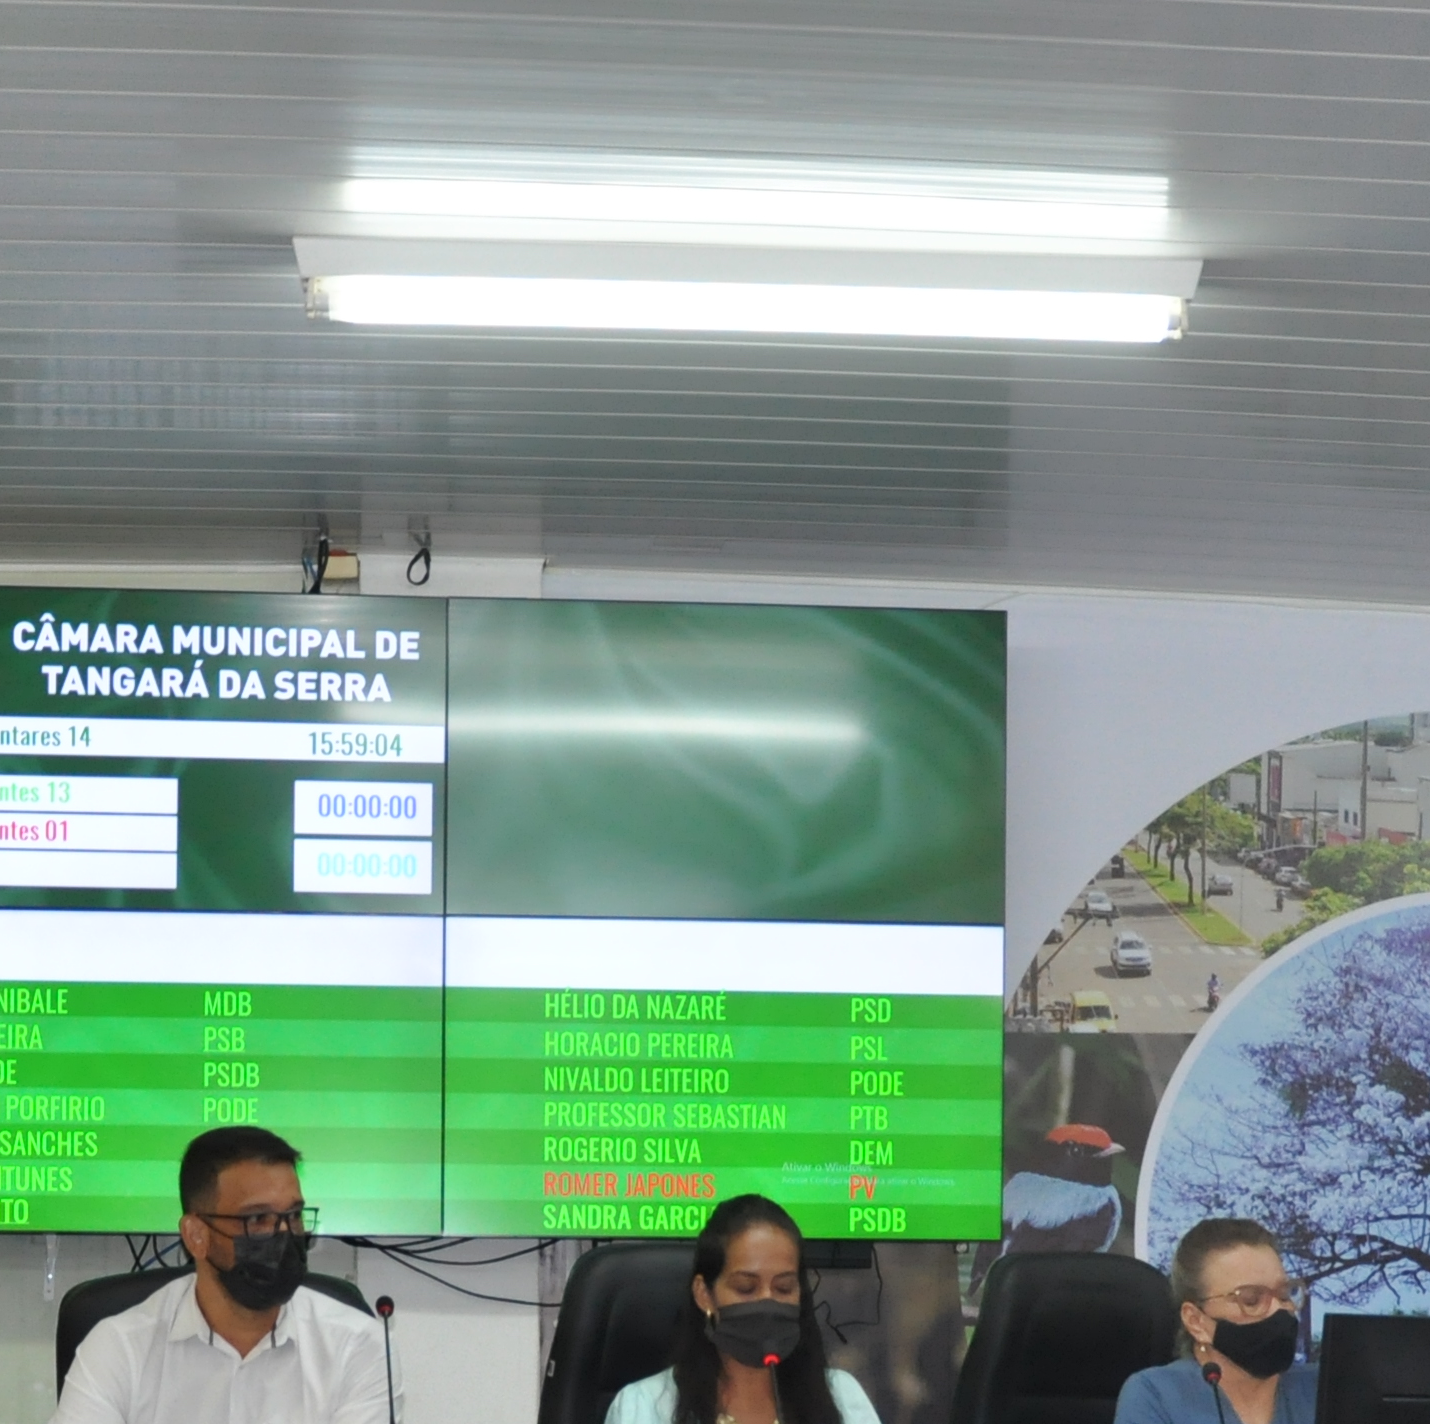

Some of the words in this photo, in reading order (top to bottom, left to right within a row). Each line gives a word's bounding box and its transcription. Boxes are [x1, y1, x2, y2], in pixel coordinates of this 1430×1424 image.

[12, 613, 164, 653] CÂMARA
[173, 623, 366, 660] MUNICIPAL
[376, 630, 420, 662] DE
[41, 658, 208, 699] TANGARÁ
[219, 668, 266, 700] DA
[272, 670, 392, 702] SERRA
[68, 724, 92, 748] 14
[308, 731, 403, 758] 15:59:04
[46, 781, 71, 804] 13
[317, 793, 417, 820] 00:00:00
[45, 818, 69, 842] 01
[316, 852, 417, 879] 00:00:00
[203, 991, 253, 1018] MDB
[544, 988, 605, 1019] HÉLIO
[612, 993, 639, 1020] DA
[647, 990, 727, 1021] NAZARÉ
[850, 997, 892, 1024] PSD
[203, 1026, 246, 1053] PSB
[544, 1031, 640, 1058] HORACIO
[647, 1032, 734, 1060] PEREIRA
[850, 1035, 888, 1062] PSL
[203, 1062, 260, 1089] PSDB
[544, 1067, 633, 1094] NIVALDO
[640, 1068, 730, 1095] LEITEIRO
[850, 1070, 905, 1097] PODE
[5, 1095, 105, 1122] PORFIRIO
[203, 1097, 259, 1124] PODE
[544, 1102, 666, 1129] PROFESSOR
[673, 1103, 787, 1130] SEBASTIAN
[850, 1105, 889, 1132] PTB
[543, 1136, 636, 1164] ROGERIO
[643, 1137, 702, 1165] SILVA
[849, 1140, 894, 1166] DEM
[782, 1162, 812, 1172] Ativar
[543, 1171, 617, 1199] ROMER
[624, 1172, 716, 1199] JAPONES
[849, 1174, 878, 1201] PV
[543, 1204, 631, 1232] SANDRA
[638, 1205, 715, 1232] GARCI
[849, 1206, 907, 1234] PSDB
